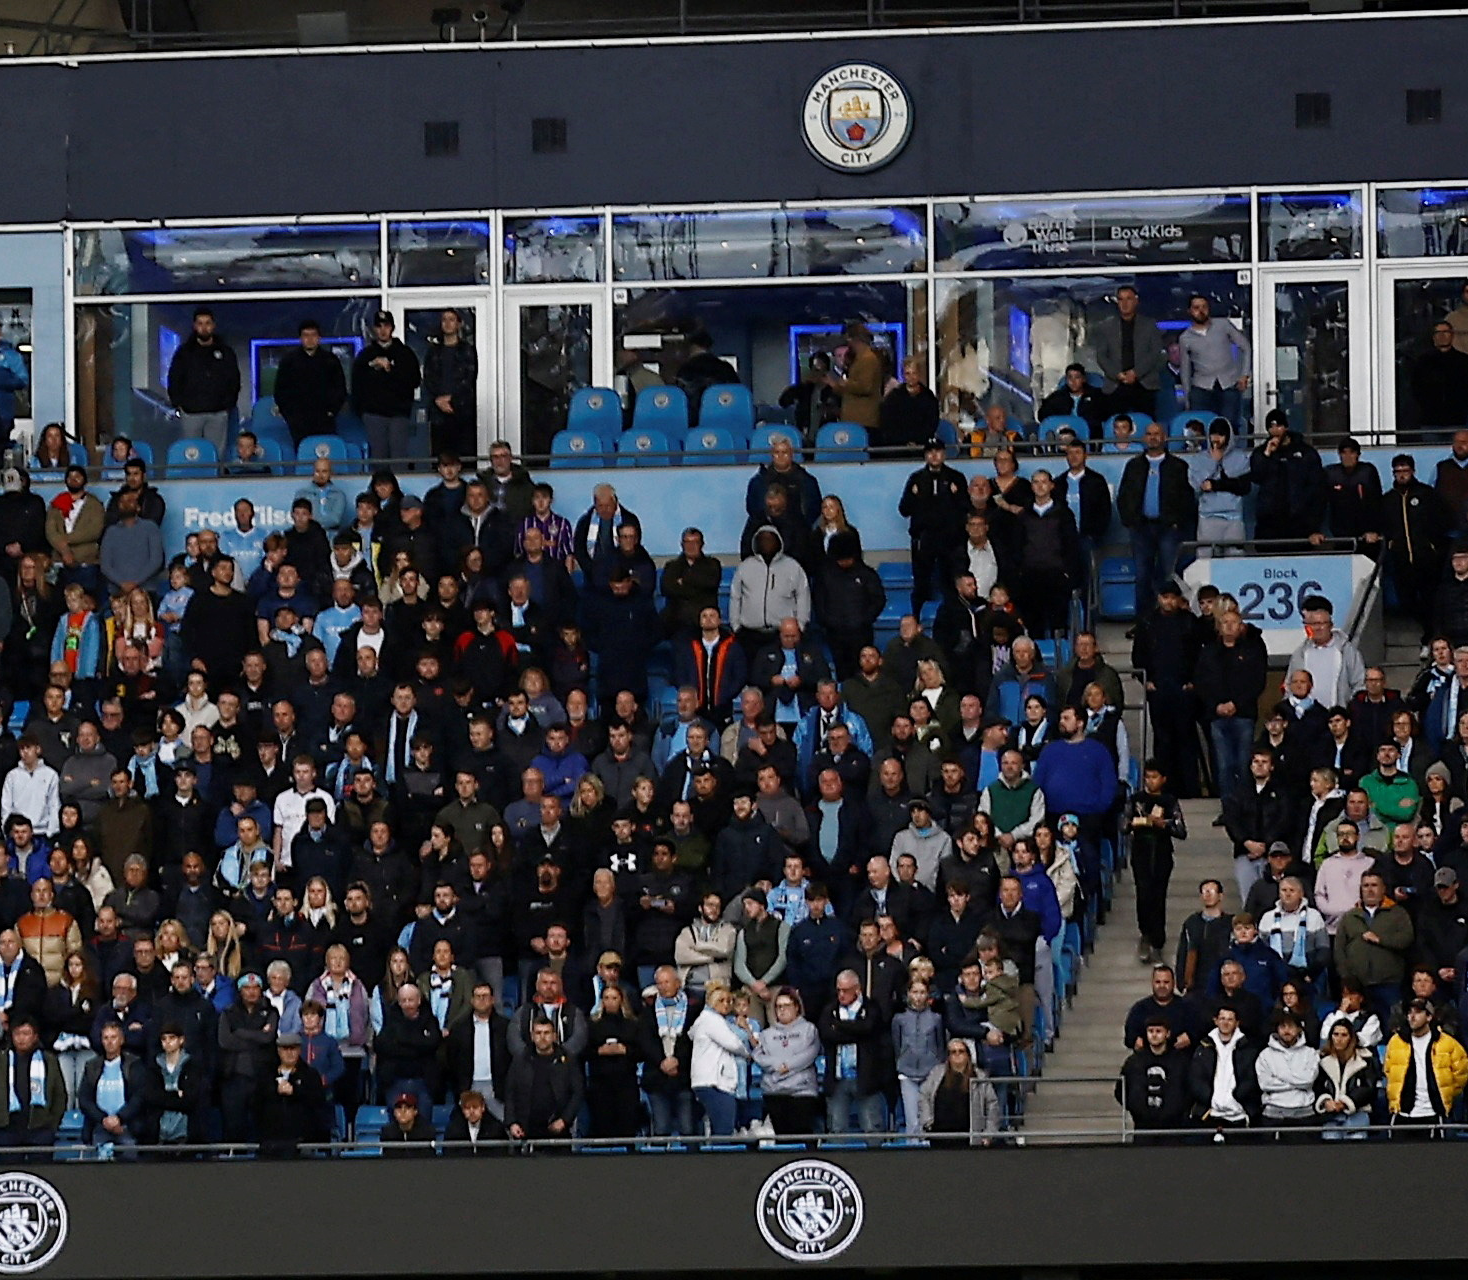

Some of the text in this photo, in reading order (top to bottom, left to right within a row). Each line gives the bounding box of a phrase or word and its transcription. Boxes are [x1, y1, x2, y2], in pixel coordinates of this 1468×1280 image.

[812, 68, 900, 104] MANCHESTER
[840, 151, 873, 163] CITY
[1110, 224, 1183, 239] Box4Kids
[184, 506, 236, 528] Fred
[1264, 568, 1298, 579] Block
[769, 1168, 850, 1200] MANCHESTER
[795, 1242, 825, 1252] CITY
[1, 1253, 31, 1263] CITY
